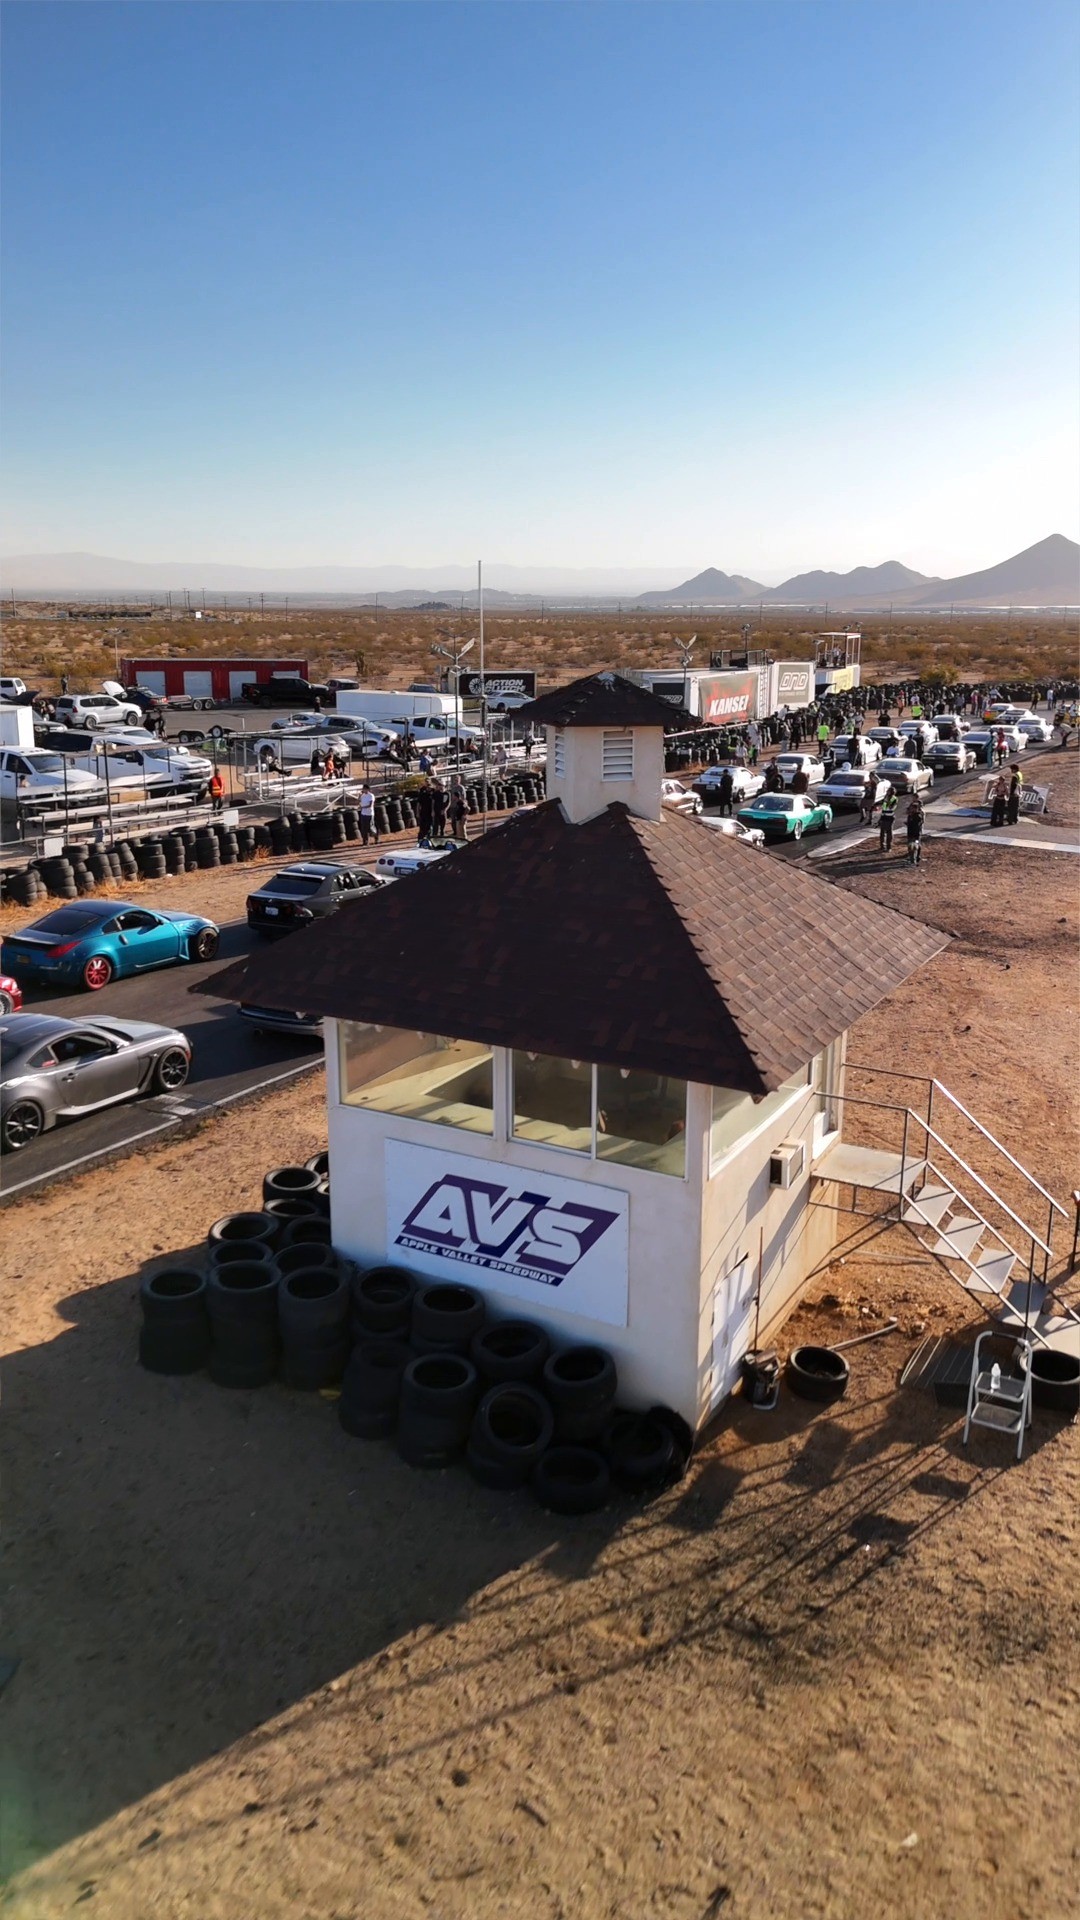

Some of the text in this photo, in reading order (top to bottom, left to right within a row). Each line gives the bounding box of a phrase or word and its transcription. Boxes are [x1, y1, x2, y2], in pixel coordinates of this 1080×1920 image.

[709, 694, 750, 717] KANSEI
[408, 1181, 600, 1267] AVS
[400, 1237, 556, 1285] APPLE VALLEY SPEEDWAY
